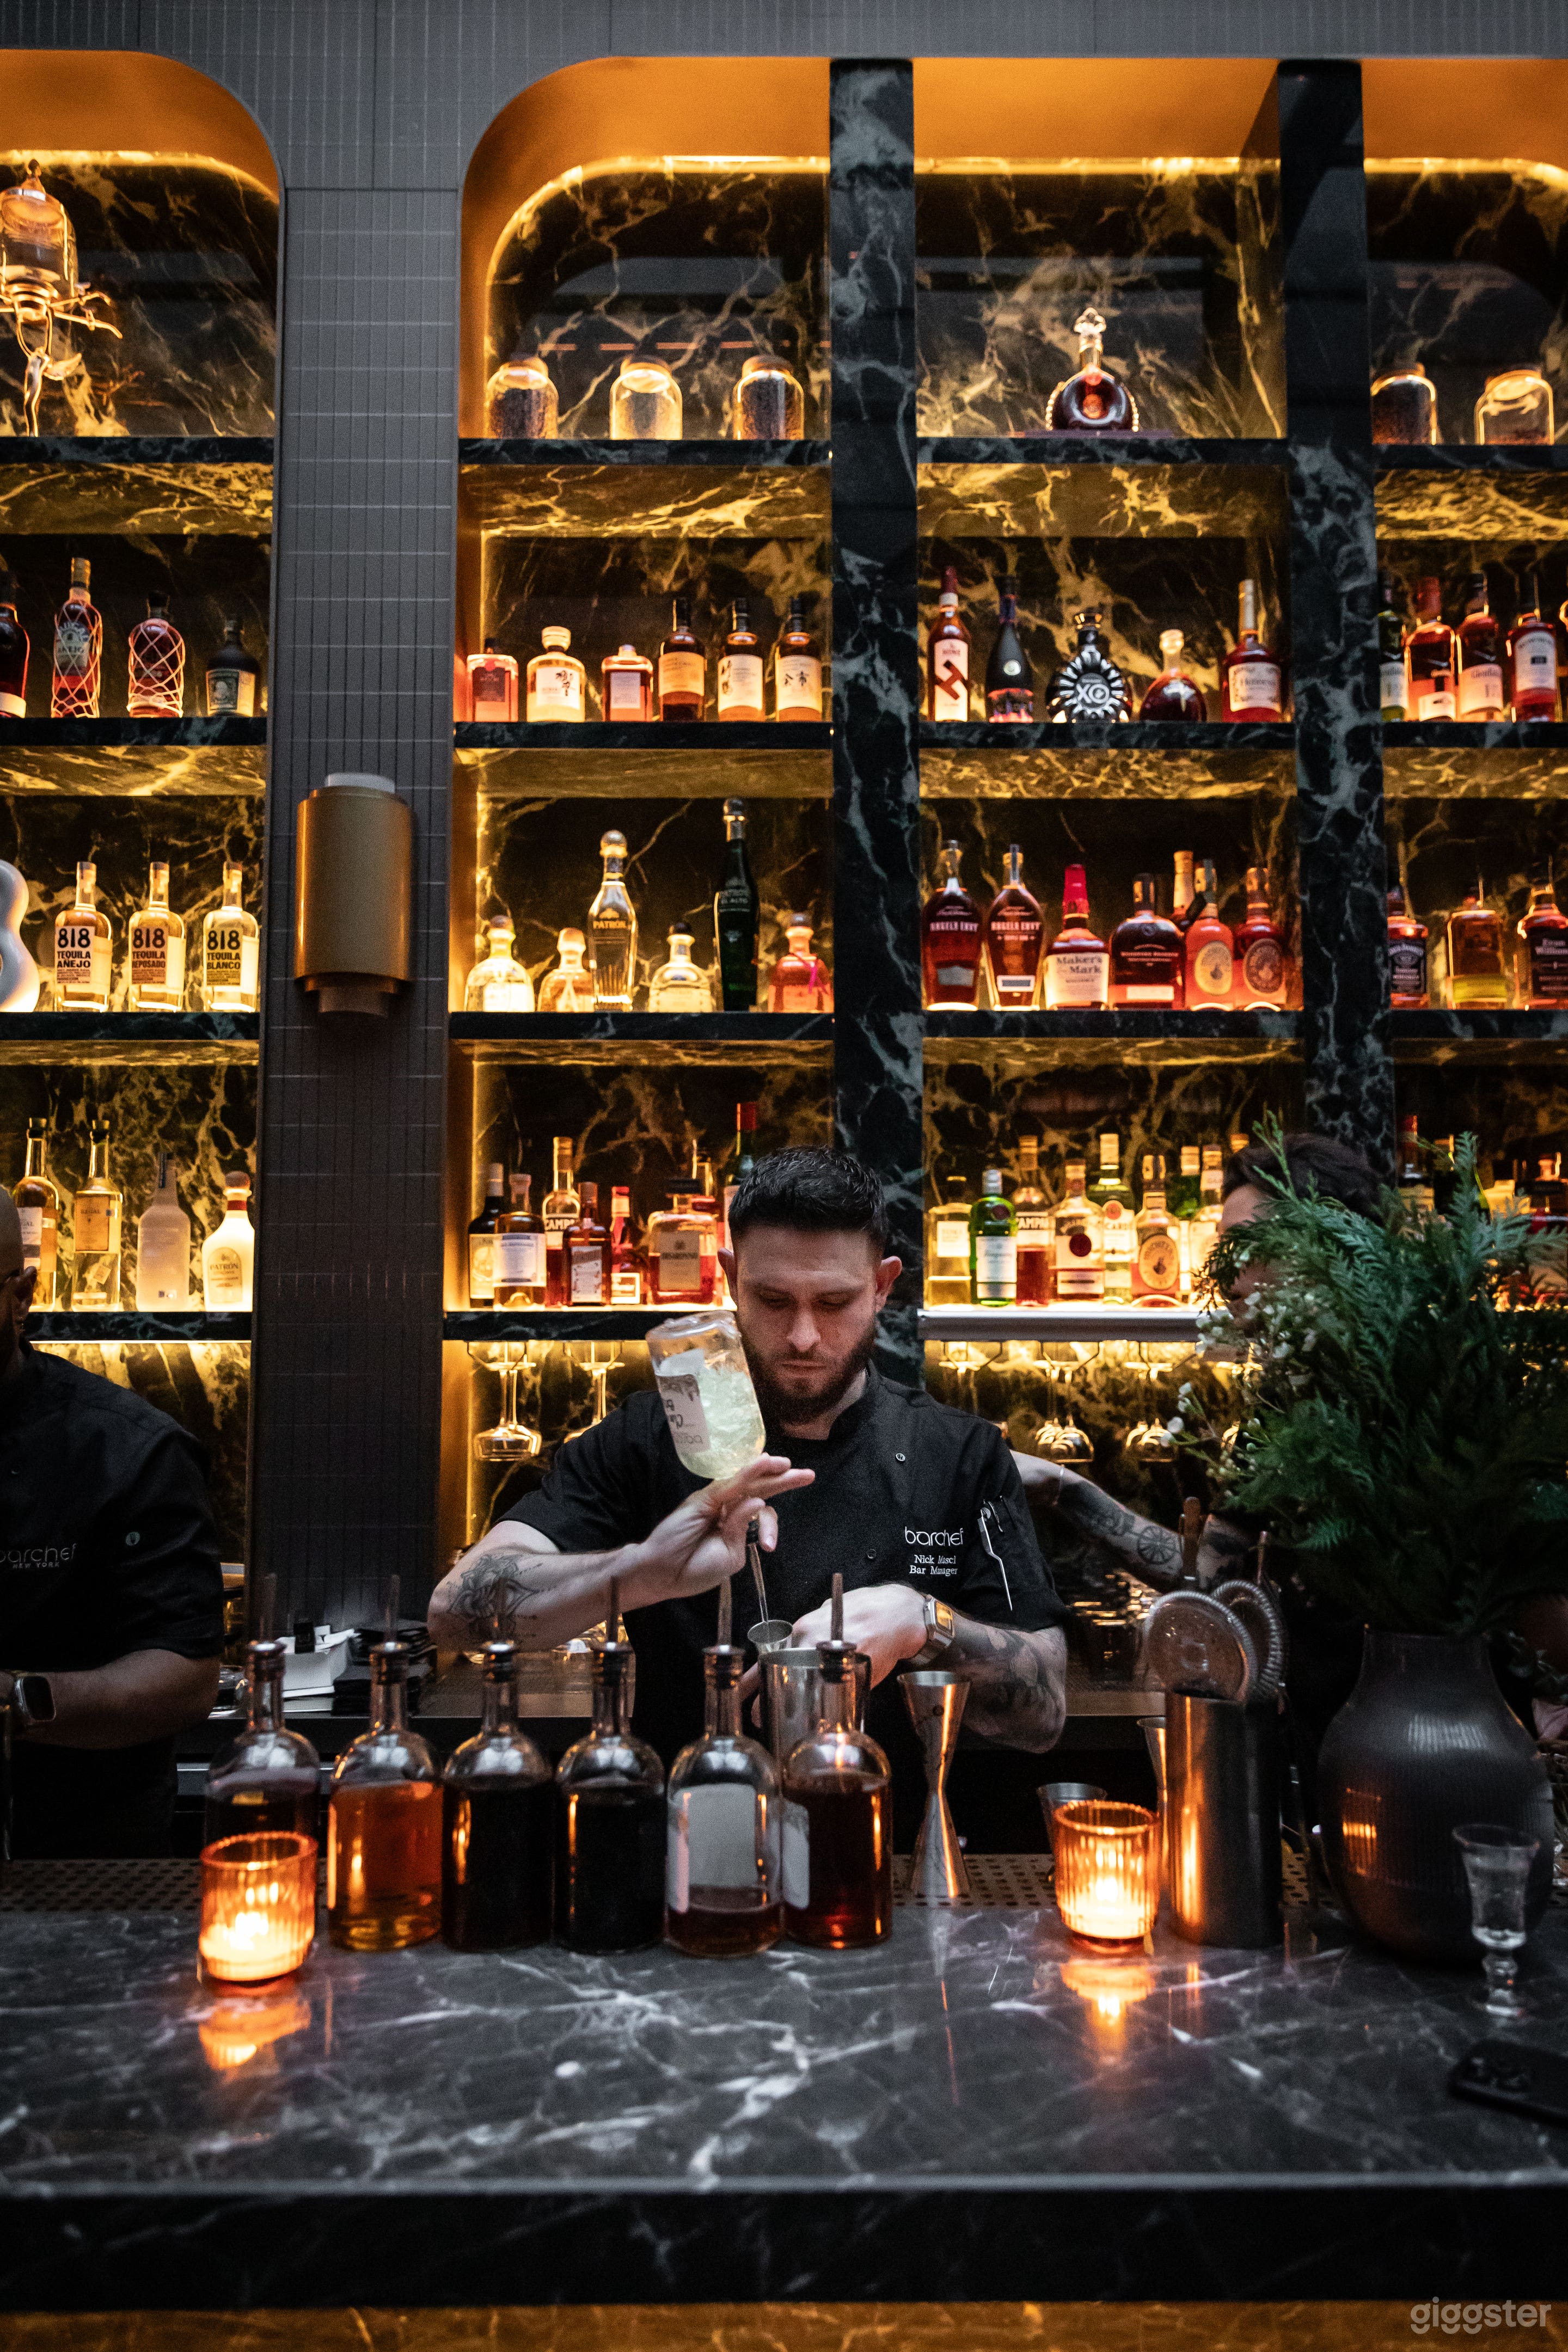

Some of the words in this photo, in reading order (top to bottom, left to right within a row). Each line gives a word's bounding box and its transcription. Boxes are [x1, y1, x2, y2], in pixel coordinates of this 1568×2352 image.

[1076, 683, 1110, 703] XO
[58, 928, 91, 948] 818
[133, 928, 165, 948] 818
[207, 930, 241, 950] 818
[57, 951, 91, 959] TEQUILA
[57, 959, 91, 967] AÑEJO
[132, 960, 166, 968] REPOSADO
[905, 1526, 964, 1546] barchef
[914, 1554, 935, 1564] Nick
[909, 1565, 926, 1575] Bar
